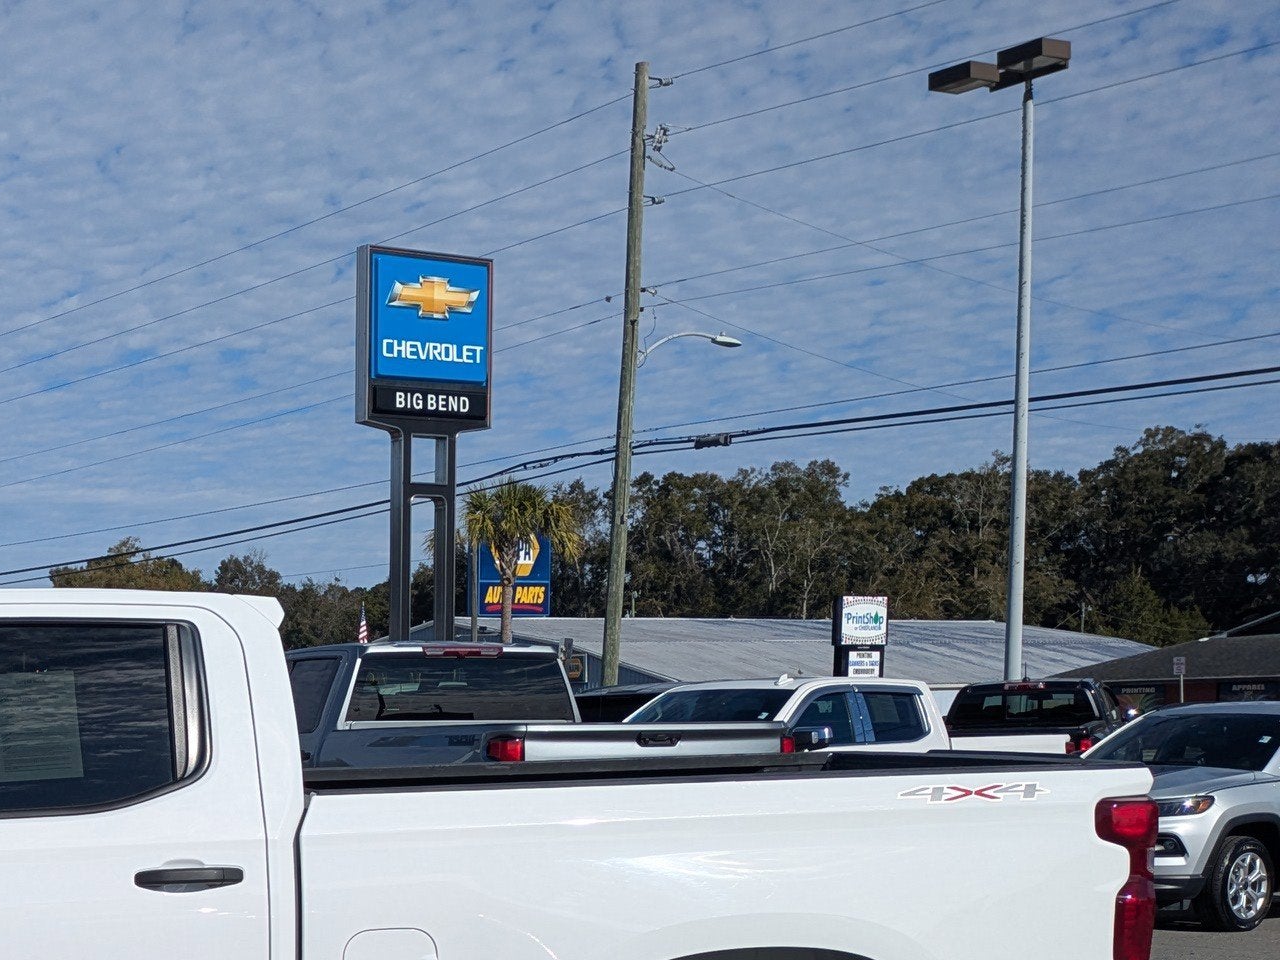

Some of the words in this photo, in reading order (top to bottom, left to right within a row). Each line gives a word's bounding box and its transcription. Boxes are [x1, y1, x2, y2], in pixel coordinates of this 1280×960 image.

[382, 339, 484, 364] CHEVROLET
[395, 391, 423, 410] BIG
[427, 393, 470, 413] BEND
[514, 586, 545, 604] PARTS
